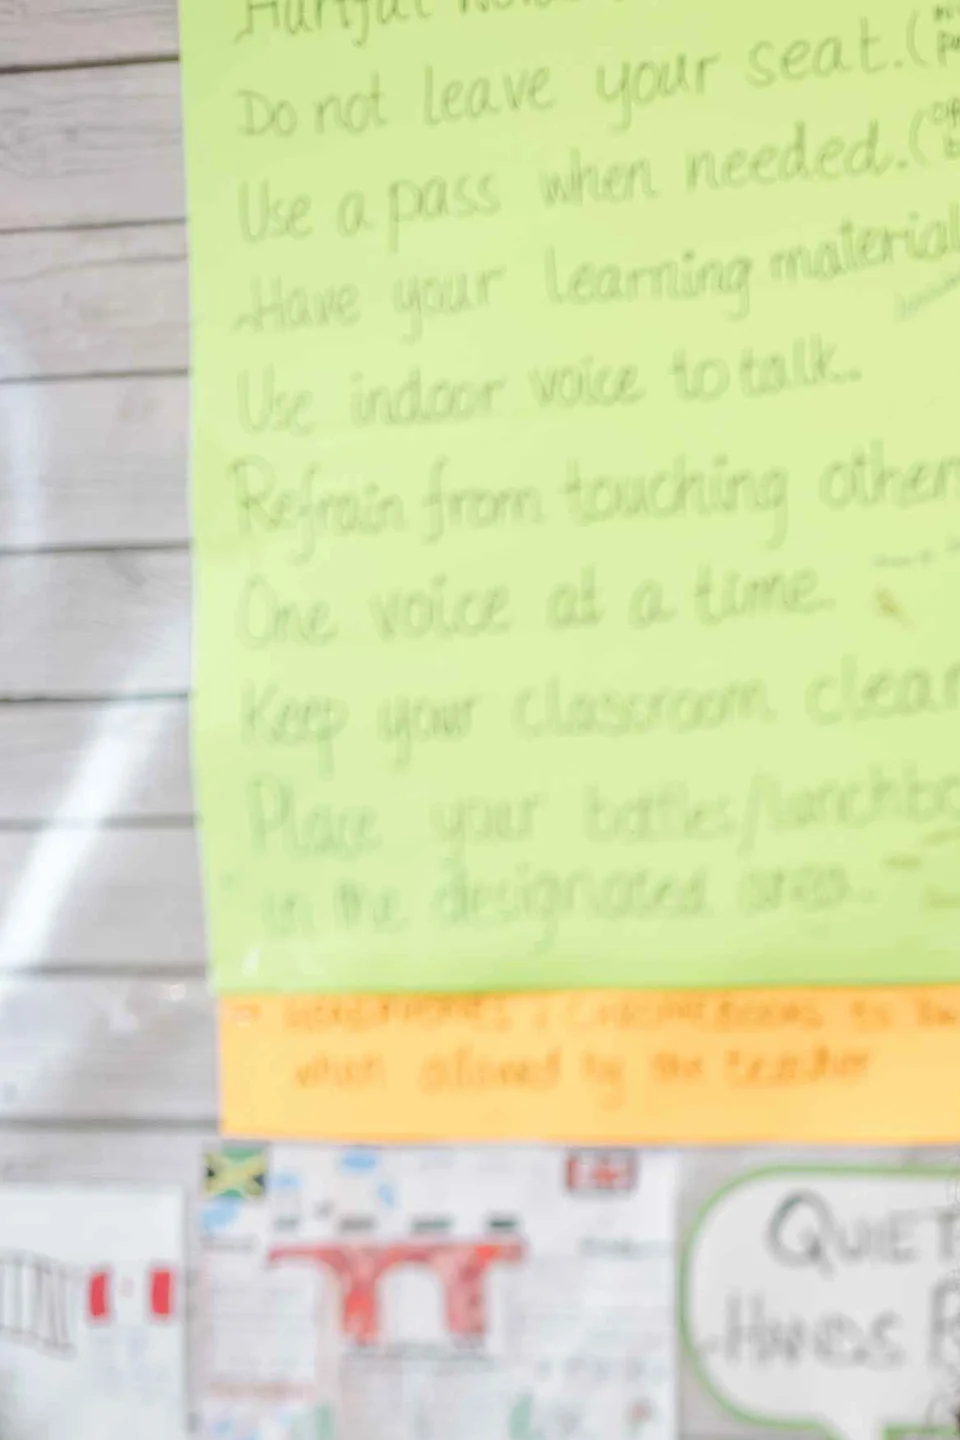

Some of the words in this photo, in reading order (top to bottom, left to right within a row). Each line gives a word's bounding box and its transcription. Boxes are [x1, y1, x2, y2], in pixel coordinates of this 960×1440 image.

[236, 88, 298, 136] Do
[314, 69, 388, 133] not
[423, 63, 556, 126] leave
[595, 52, 722, 134] your
[236, 178, 314, 243] Use
[336, 189, 374, 238] a
[387, 171, 502, 254] pass
[539, 146, 662, 206] when
[684, 117, 908, 194] needed.
[230, 272, 363, 334] Have
[391, 263, 508, 345] your
[236, 363, 316, 436] Use
[349, 365, 508, 428] indoor
[529, 355, 647, 405] voice
[669, 345, 730, 402] to
[225, 453, 408, 566] Refrain
[420, 454, 547, 545] from
[557, 452, 791, 551] touching
[234, 573, 340, 650] One
[369, 571, 514, 644] voice
[545, 561, 606, 630] at
[627, 578, 678, 630] a
[376, 692, 480, 773] your
[512, 675, 777, 738] classroom
